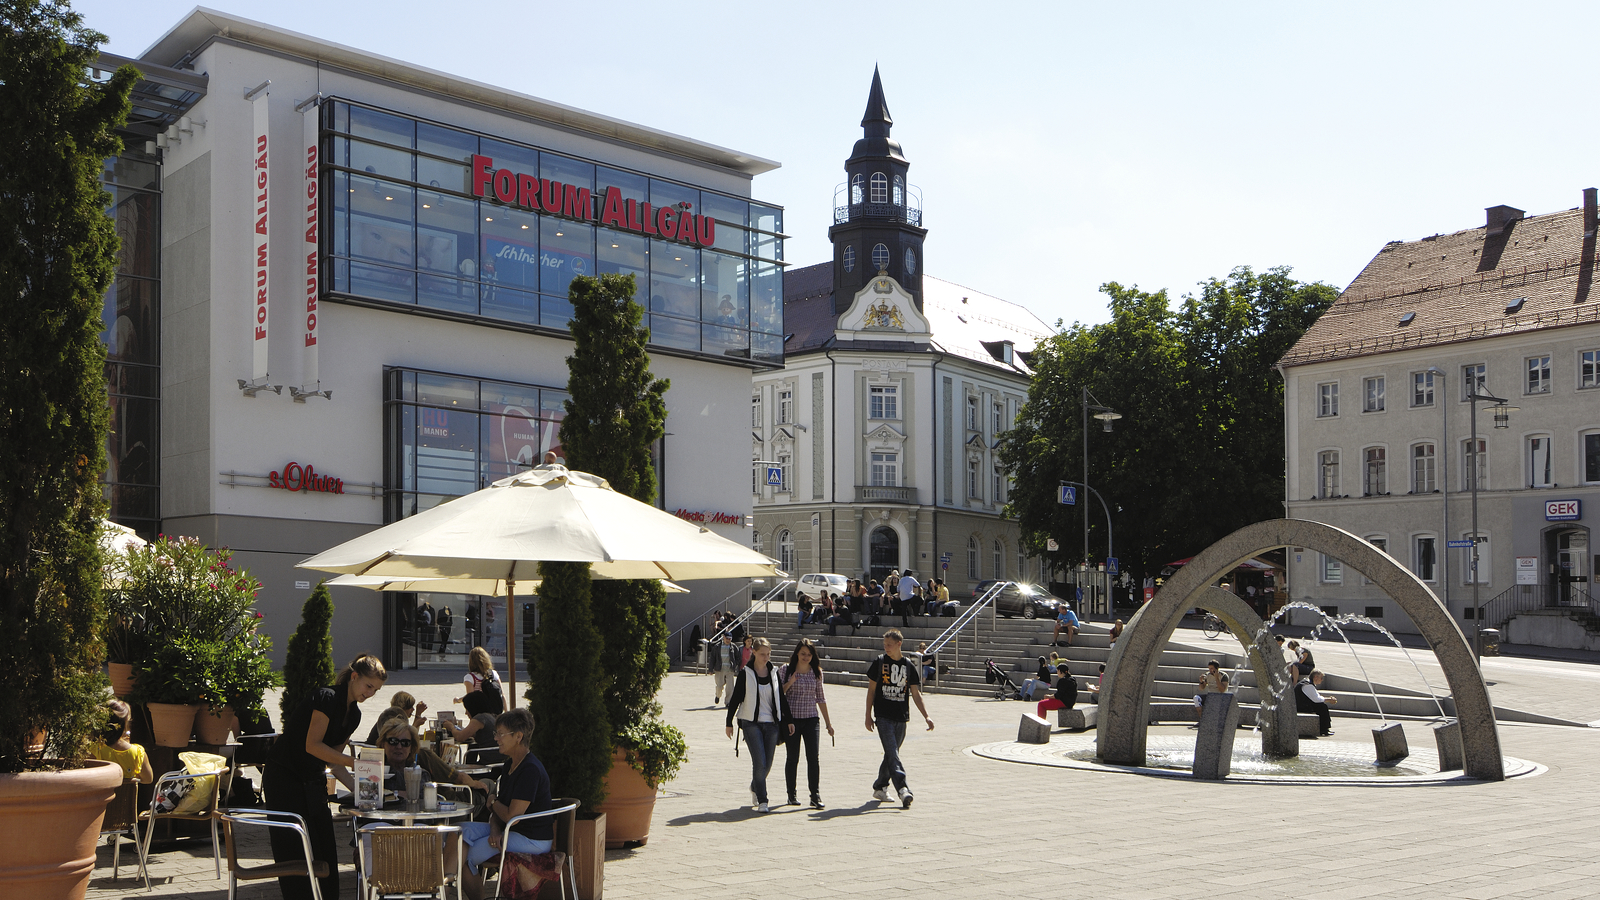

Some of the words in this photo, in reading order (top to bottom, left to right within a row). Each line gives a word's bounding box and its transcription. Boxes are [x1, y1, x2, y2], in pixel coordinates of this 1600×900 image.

[255, 134, 268, 236] ALLGÄU
[305, 145, 318, 244] ALLGÄU
[471, 153, 594, 221] FORUM
[601, 186, 716, 247] ALLGÄU
[255, 243, 268, 341] FORUM
[305, 251, 317, 347] FORUM
[269, 461, 345, 494] s.Oliver
[423, 427, 448, 437] MANIC
[675, 508, 705, 522] Media
[711, 512, 739, 525] Markt
[1548, 503, 1576, 515] GEK
